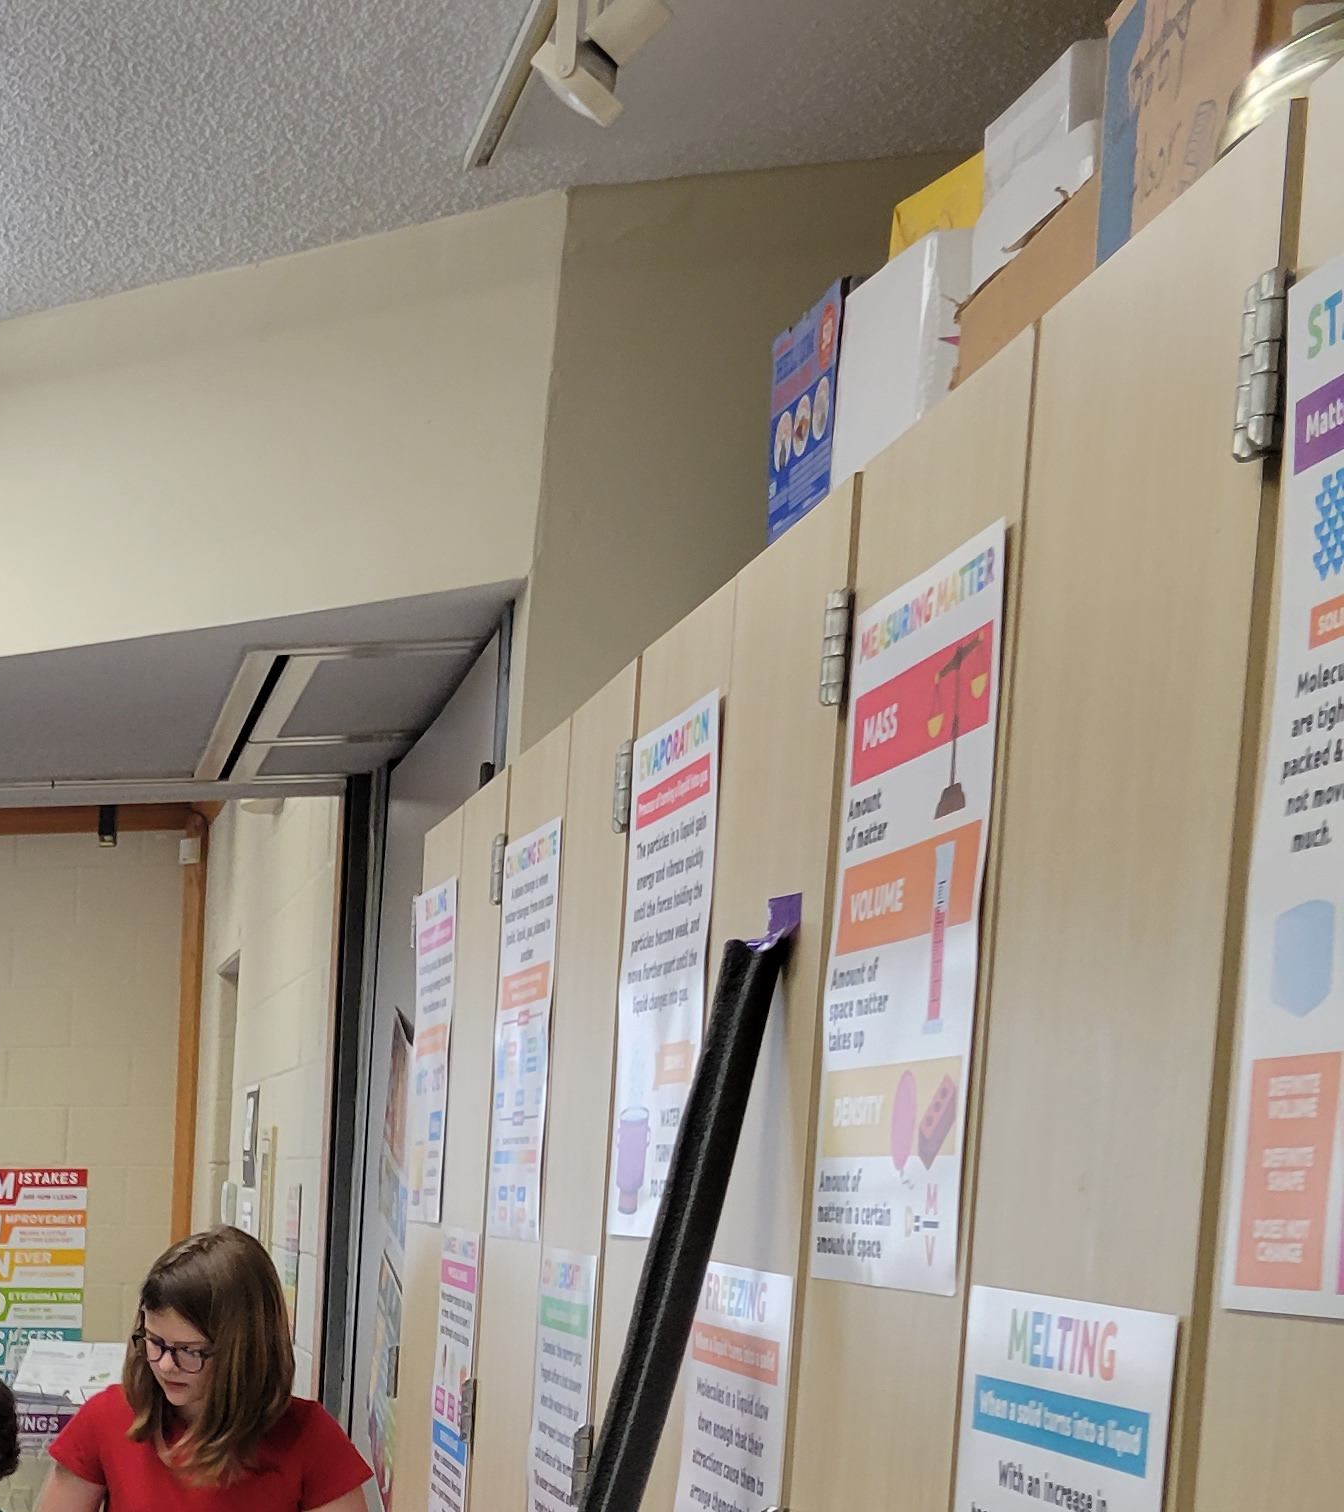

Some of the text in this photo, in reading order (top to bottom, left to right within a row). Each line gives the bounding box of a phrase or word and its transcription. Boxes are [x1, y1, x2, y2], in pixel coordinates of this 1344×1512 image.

[1307, 290, 1344, 359] ST
[1305, 398, 1344, 444] Matt
[859, 547, 995, 664] MEASURING MATTER
[1296, 664, 1344, 698] Molecu
[863, 702, 899, 751] MASS
[1292, 697, 1344, 738] are tigh
[639, 708, 710, 782] EVAPORATION
[1280, 739, 1333, 785] packed
[847, 789, 882, 823] Amount
[1284, 783, 1344, 817] not mov
[846, 821, 888, 852] of matter
[850, 878, 905, 923] VOLUME
[830, 957, 879, 991] Amount of
[829, 993, 889, 1025] space matter
[828, 1030, 864, 1053] takes up
[833, 1095, 884, 1127] DENSITY
[818, 1168, 862, 1192] Amount of
[818, 1203, 843, 1223] matter
[845, 1201, 852, 1224] in
[861, 1203, 891, 1226] certain
[817, 1232, 882, 1262] amount of space
[705, 1272, 768, 1322] FREEZING
[1008, 1308, 1118, 1382] MELTING
[696, 1376, 724, 1406] Molecules
[725, 1385, 731, 1407] in
[736, 1389, 754, 1416] liquid
[755, 1398, 770, 1421] slow
[698, 1411, 763, 1458] down enough that their
[979, 1389, 1006, 1415] When
[1017, 1399, 1041, 1427] solid
[1073, 1411, 1095, 1441] into
[1106, 1420, 1141, 1457] liquid
[692, 1448, 764, 1497] attractions cause them to
[998, 1460, 1024, 1495] With
[1027, 1474, 1040, 1498] an
[690, 1483, 711, 1510] arrange
